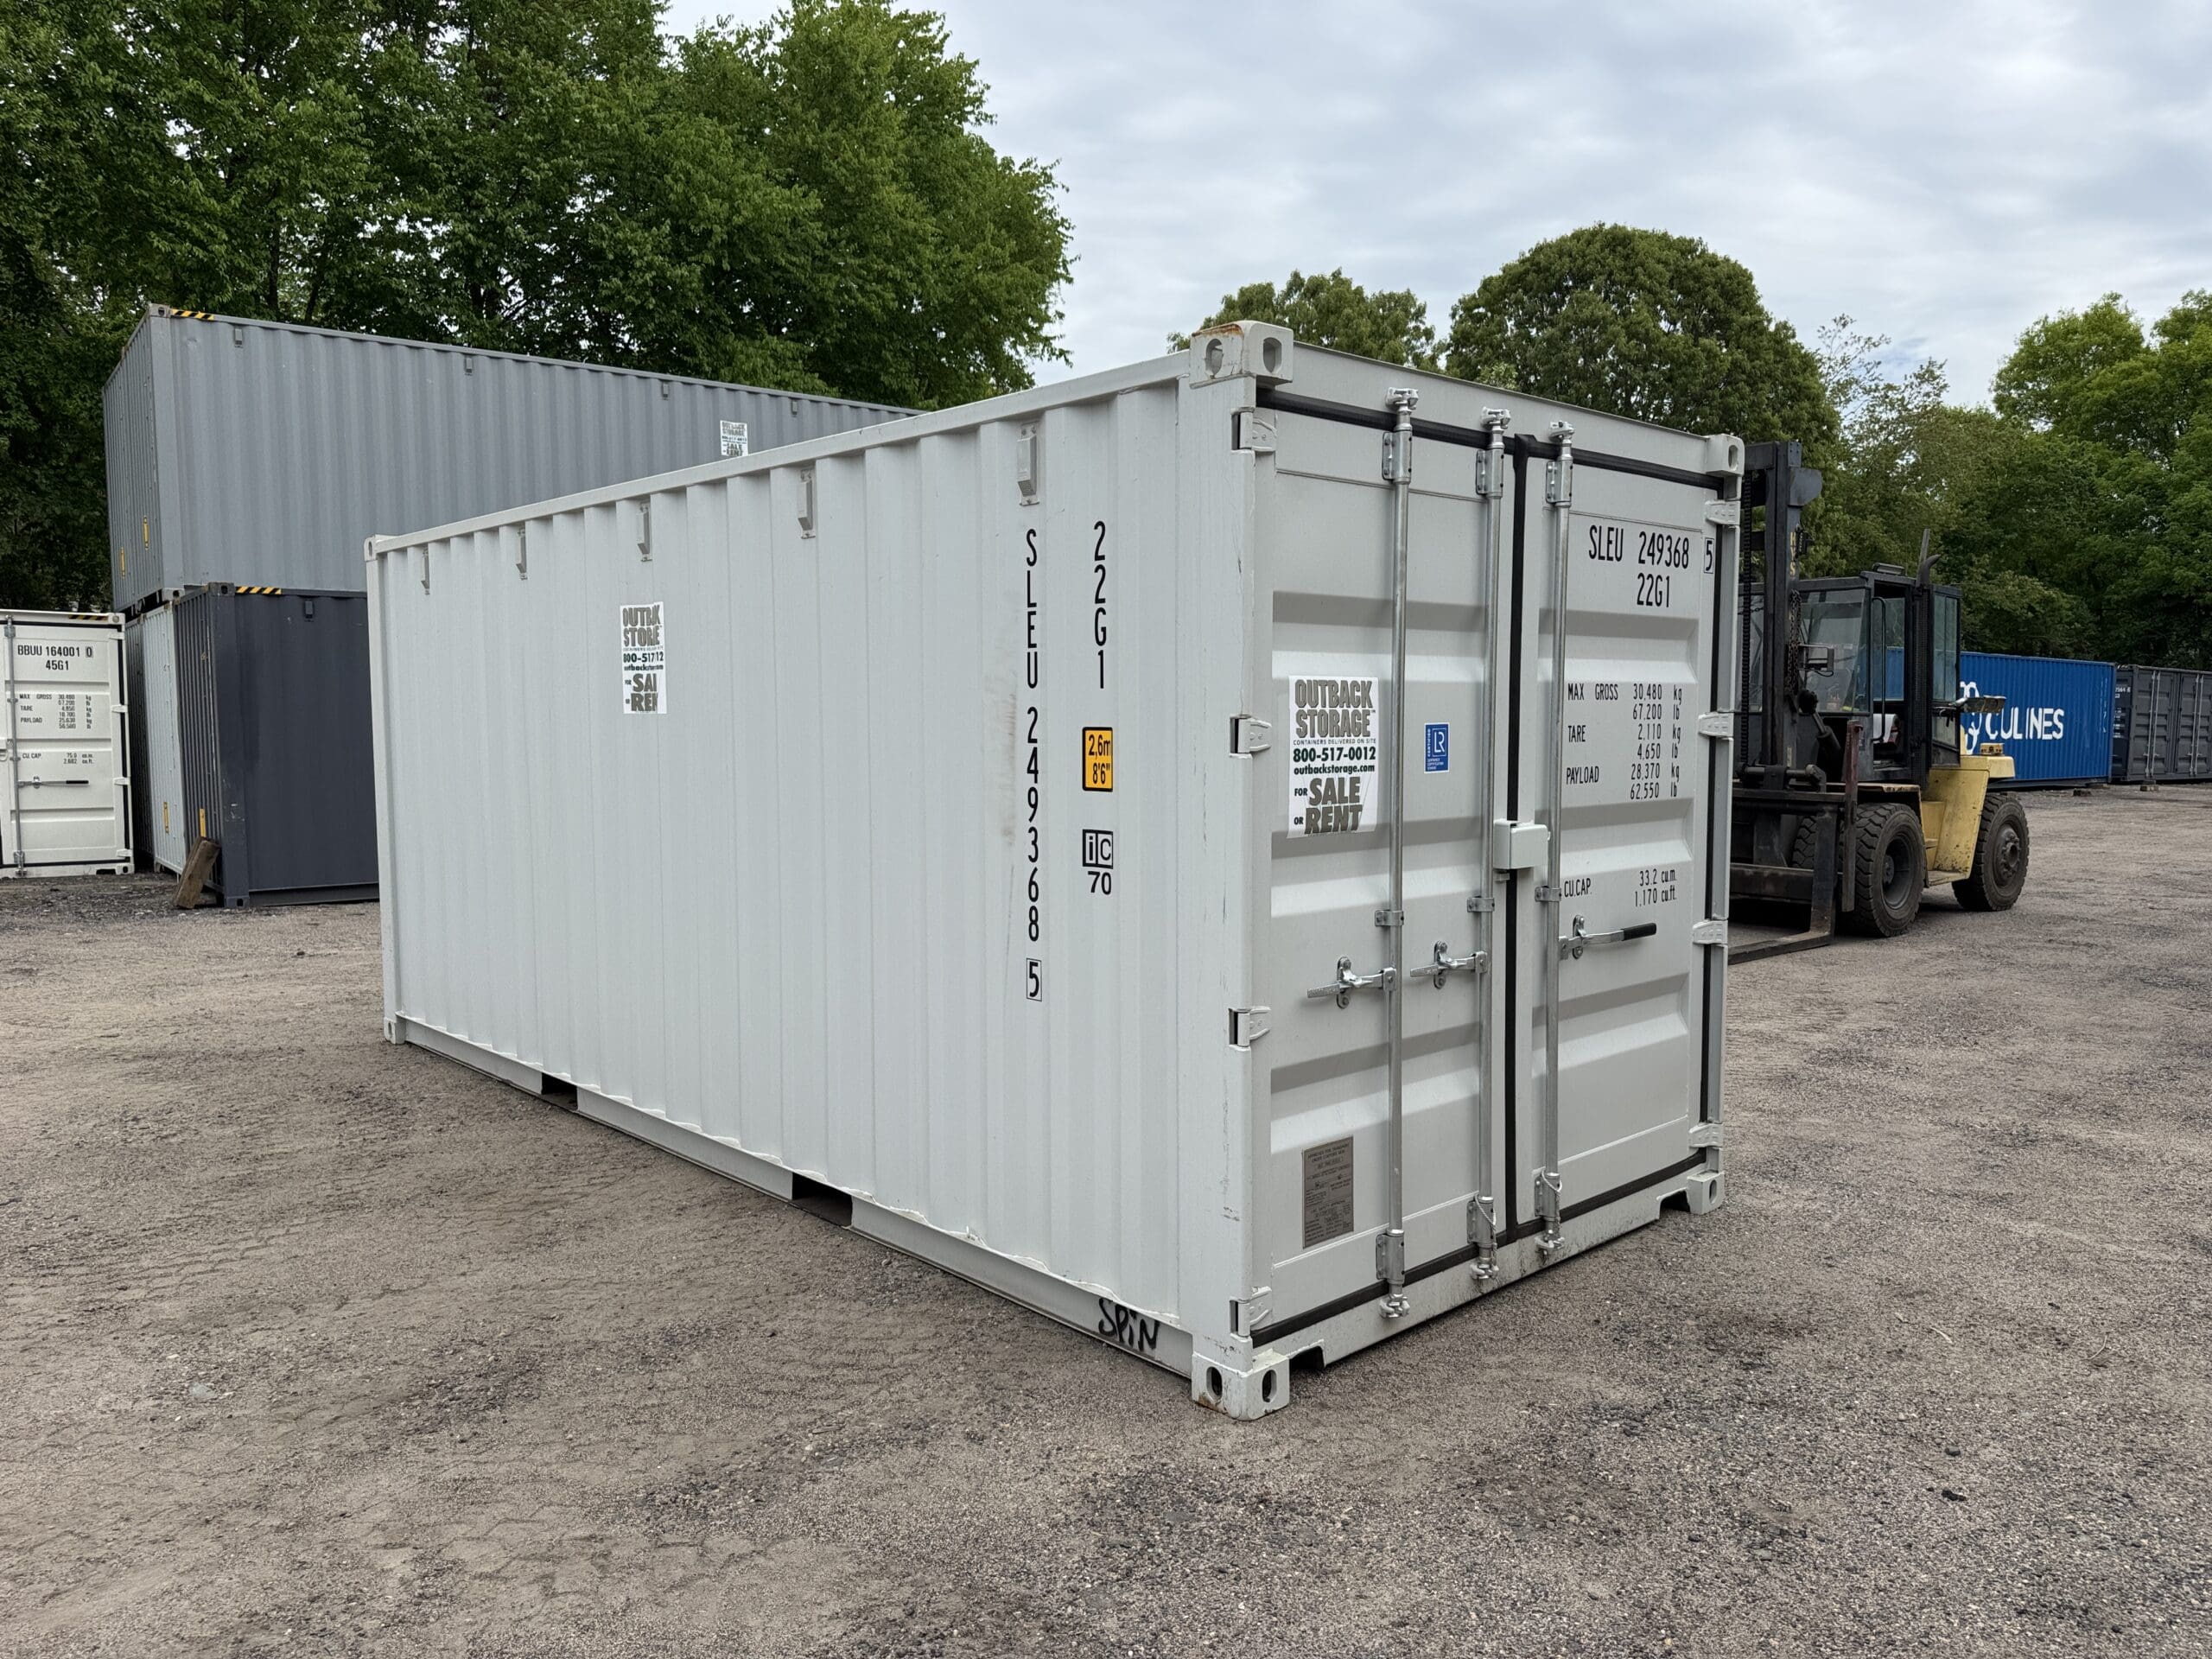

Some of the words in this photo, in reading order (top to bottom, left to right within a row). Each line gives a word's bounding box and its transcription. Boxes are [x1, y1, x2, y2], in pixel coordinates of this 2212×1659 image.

[1589, 524, 1624, 562] SLEU
[1638, 531, 1689, 569] 249368
[1705, 539, 1713, 572] 5
[1637, 573, 1669, 607] 22G1
[1027, 528, 1038, 689] SLEU
[1093, 521, 1106, 689] 22G1
[17, 645, 41, 656] BBUU
[46, 646, 79, 657] 164001
[46, 660, 68, 671] 45G1
[1294, 679, 1373, 709] OUTBACK
[1567, 683, 1585, 701] MAX
[1594, 683, 1618, 700] GROSS
[1674, 684, 1681, 705] kg
[1674, 703, 1680, 720] lb
[1295, 709, 1370, 738] STORAGE
[1567, 725, 1586, 742] TARE
[1673, 724, 1681, 744] kg
[1294, 747, 1376, 762] 800-517-0012
[1672, 743, 1678, 759] lb
[1294, 763, 1375, 774] outbackstorage.com
[1567, 766, 1599, 785] PAYLOAD
[1671, 764, 1680, 782] kg
[1294, 788, 1307, 797] FOR
[1309, 777, 1361, 805] SALE
[1670, 783, 1677, 798] lb
[1027, 706, 1039, 942] 249368
[1305, 805, 1363, 834] RENT
[1088, 871, 1112, 894] 70
[1639, 868, 1657, 887] 33.2
[1027, 960, 1040, 999] 5
